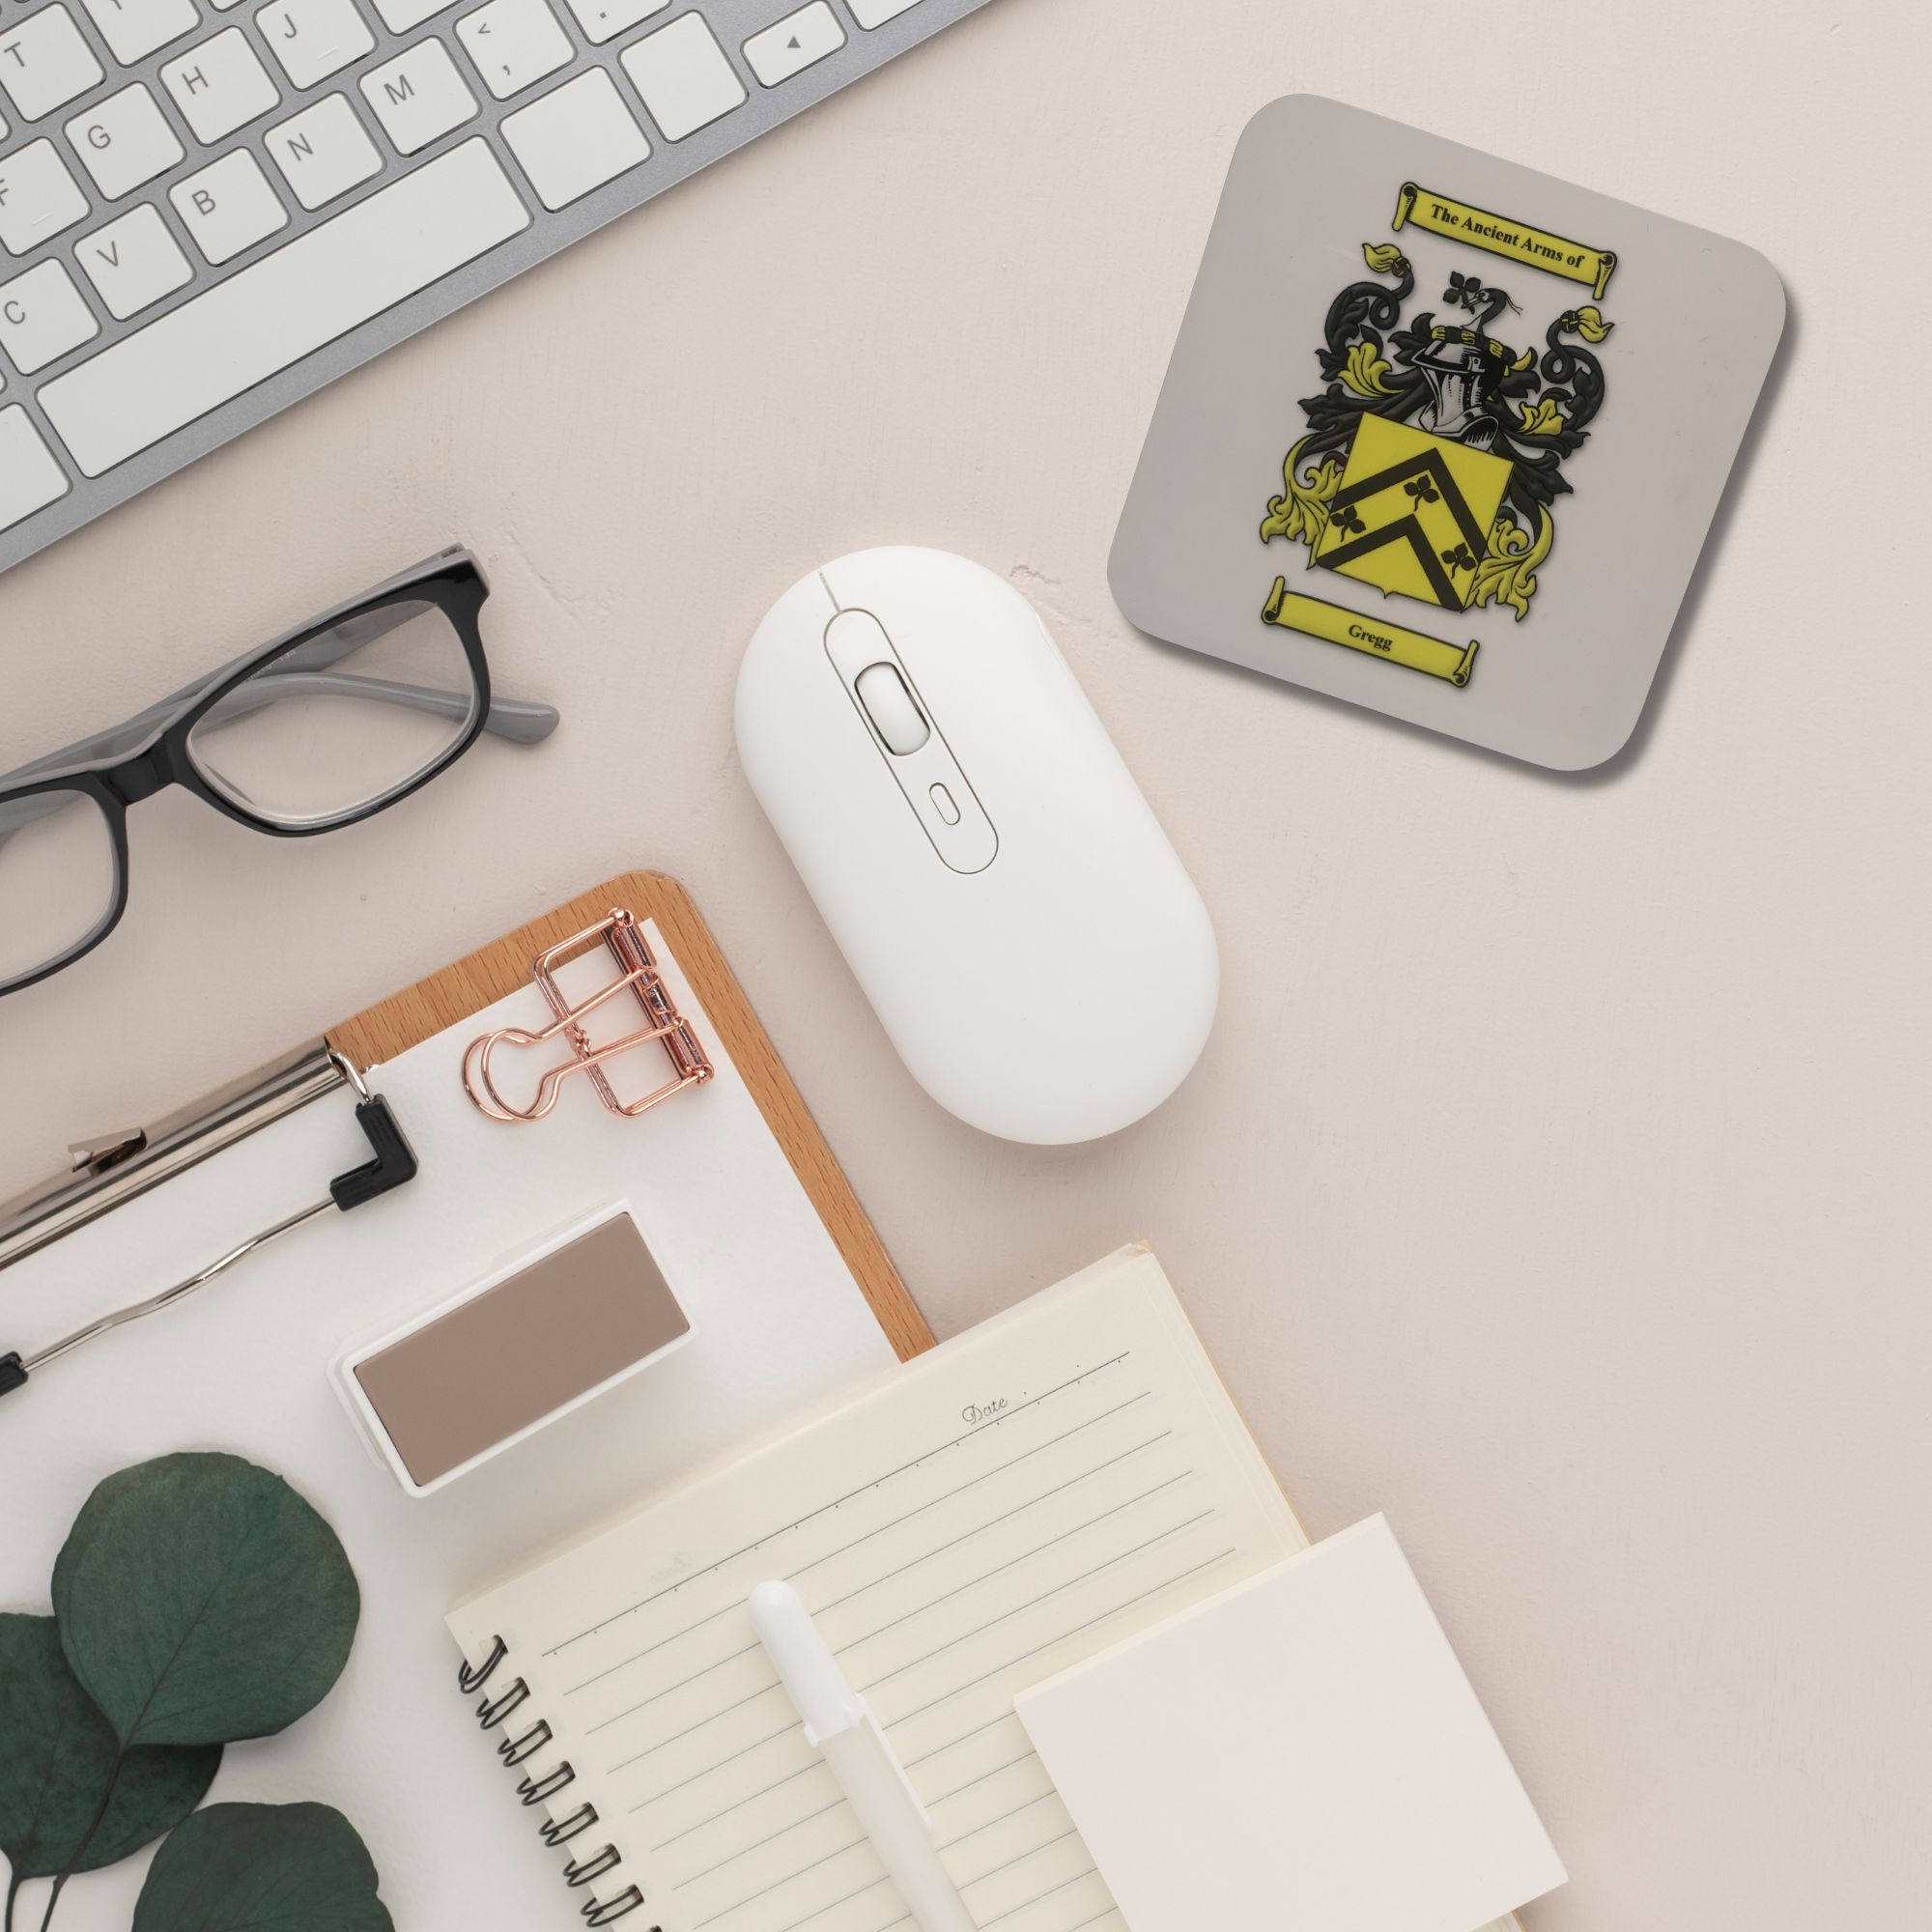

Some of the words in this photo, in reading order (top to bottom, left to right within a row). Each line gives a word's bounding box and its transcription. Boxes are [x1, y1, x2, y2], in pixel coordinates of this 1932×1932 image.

[283, 13, 298, 40] J
[3, 42, 26, 69] T
[181, 65, 210, 96] H
[383, 73, 415, 106] M
[87, 124, 112, 151] G
[286, 131, 314, 162] N
[190, 188, 216, 217] B
[1432, 204, 1459, 225] The
[1461, 216, 1520, 246] Ancient
[1520, 238, 1563, 262] Arms
[1567, 255, 1586, 269] of
[96, 240, 120, 268] V
[3, 299, 26, 326] C
[1348, 624, 1394, 652] Gregg
[961, 1398, 1009, 1426] Date
